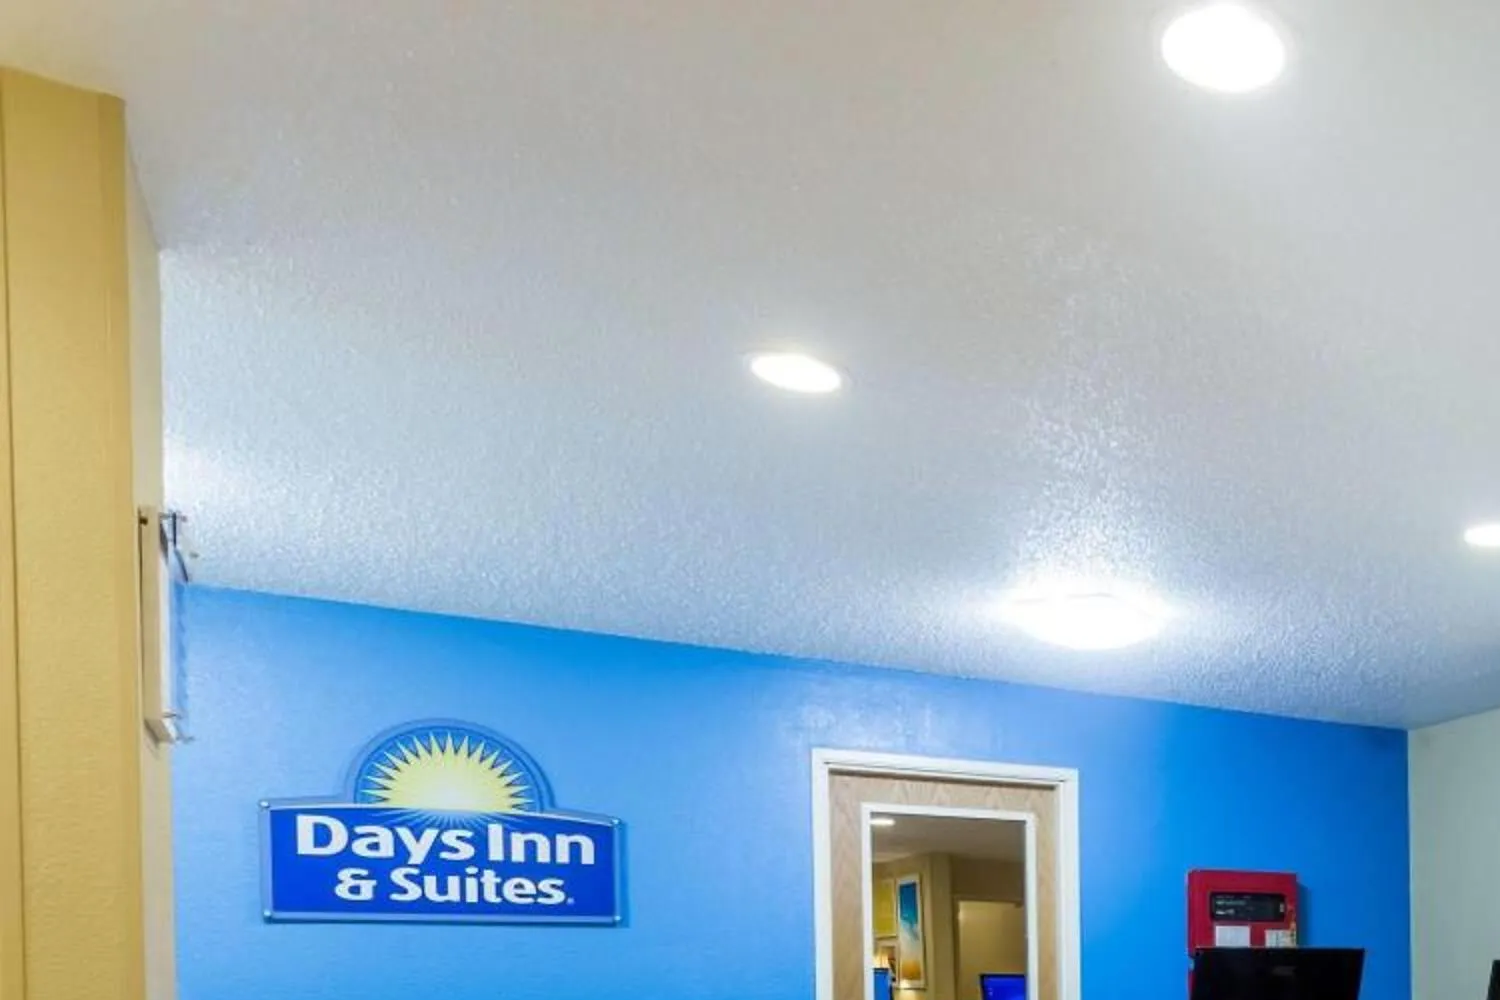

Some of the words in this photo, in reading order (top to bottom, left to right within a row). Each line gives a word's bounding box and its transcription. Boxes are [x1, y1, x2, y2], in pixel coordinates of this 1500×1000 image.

[295, 814, 476, 865] Days
[486, 822, 596, 865] Inn
[334, 868, 378, 901] &
[389, 867, 566, 905] Suites
